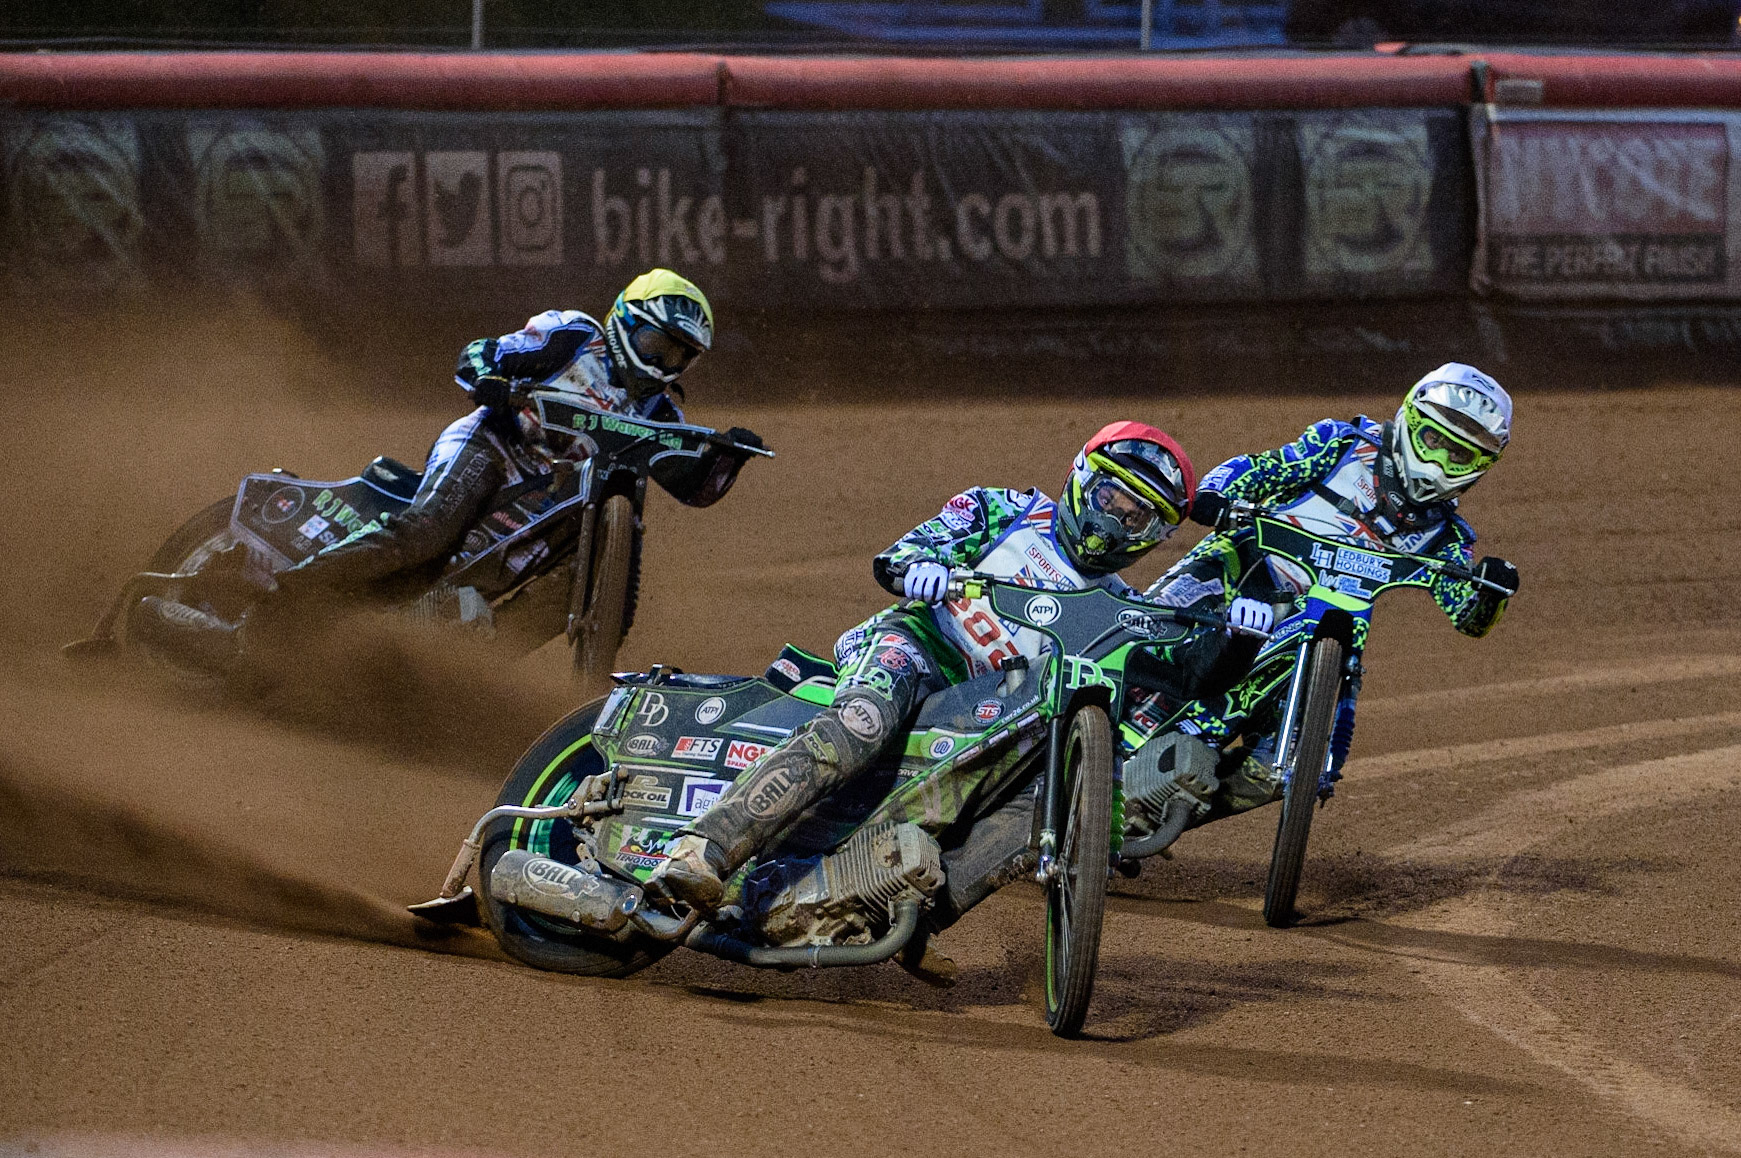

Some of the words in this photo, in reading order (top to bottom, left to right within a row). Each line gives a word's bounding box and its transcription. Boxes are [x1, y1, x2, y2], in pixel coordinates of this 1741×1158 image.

[591, 165, 1100, 283] bike-right.com
[1028, 547, 1062, 582] SPORTS
[1338, 551, 1384, 567] LEDBURY
[1337, 560, 1389, 580] HOLDINGS
[1032, 605, 1053, 615] ATPI
[700, 705, 720, 715] ATPI
[848, 704, 875, 730] ATPI
[976, 705, 1000, 716] STS
[690, 738, 719, 753] FTS
[726, 760, 748, 768] SPARK
[621, 790, 648, 800] OCK
[648, 793, 668, 802] OIL
[694, 794, 719, 810] agi
